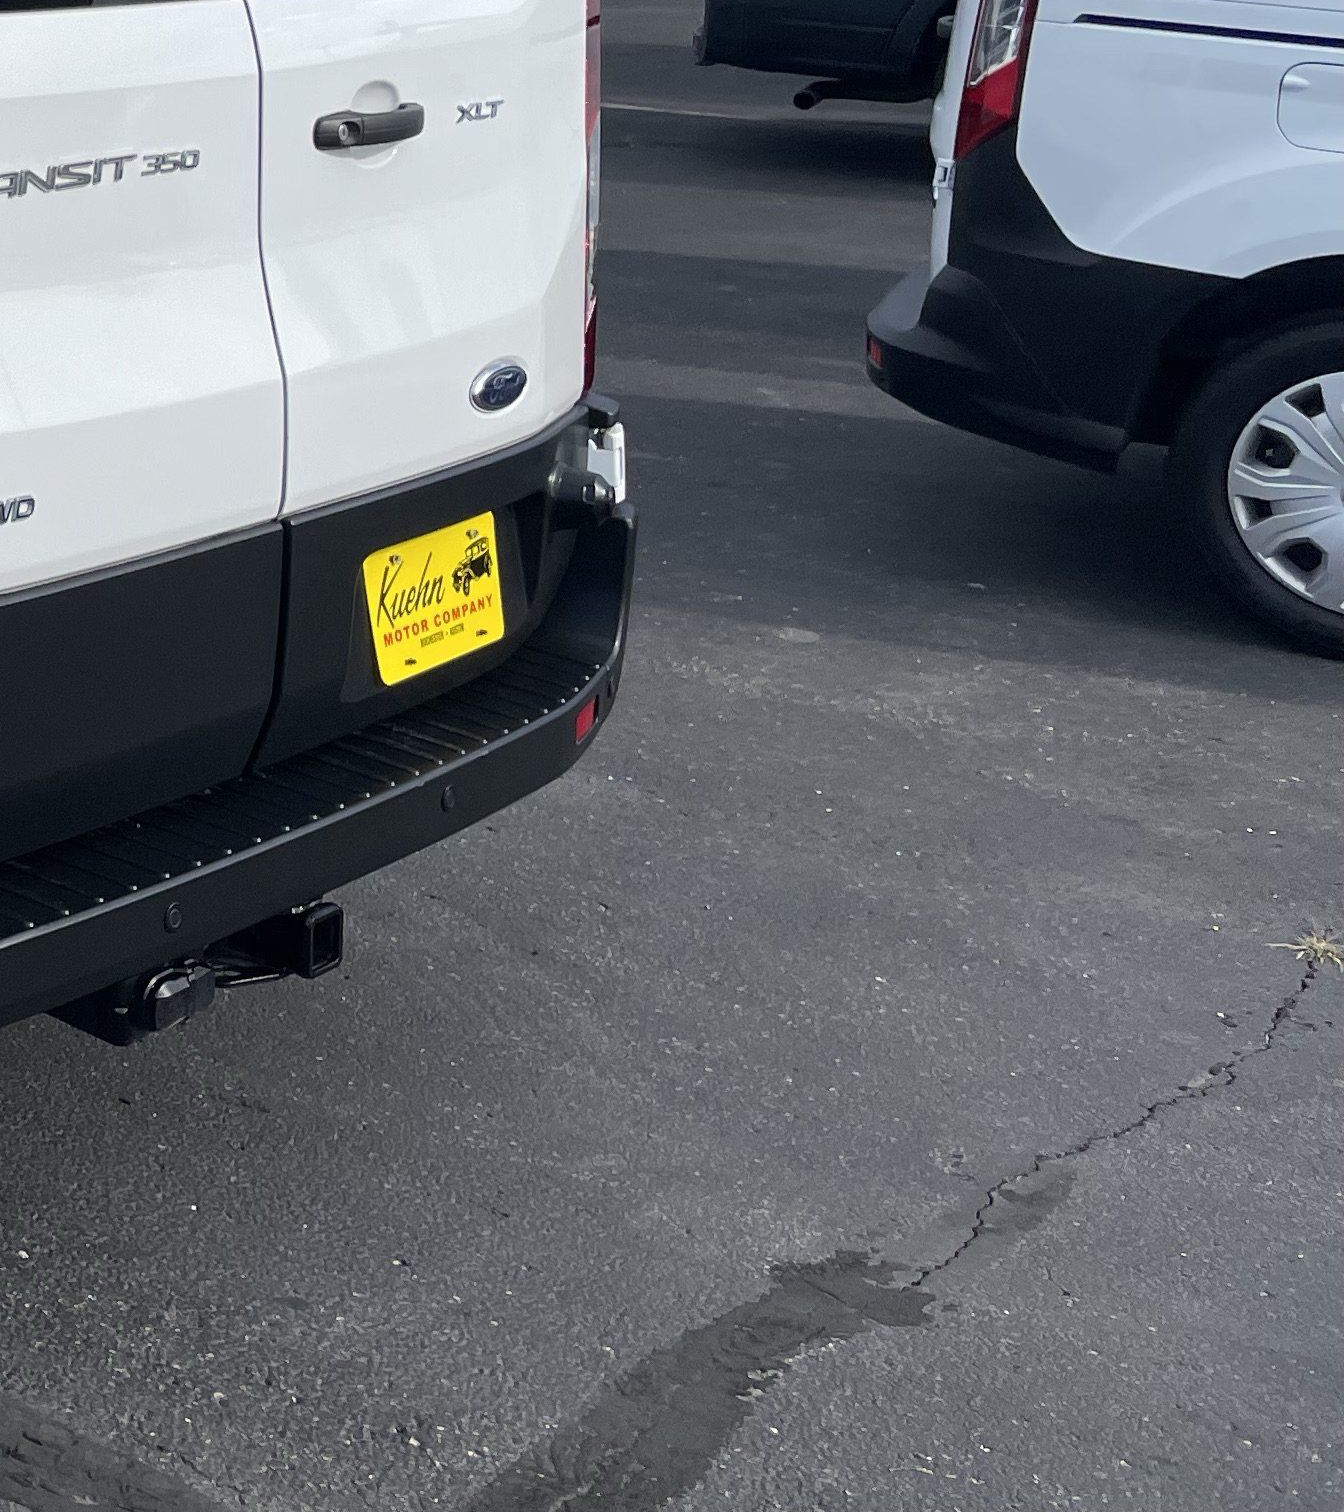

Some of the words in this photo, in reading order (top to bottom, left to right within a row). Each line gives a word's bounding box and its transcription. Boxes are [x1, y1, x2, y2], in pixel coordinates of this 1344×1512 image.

[456, 98, 505, 124] XLT
[141, 149, 201, 177] 350
[376, 551, 446, 629] Kuehn
[383, 619, 429, 648] MOTOR
[433, 593, 494, 628] COMPANY
